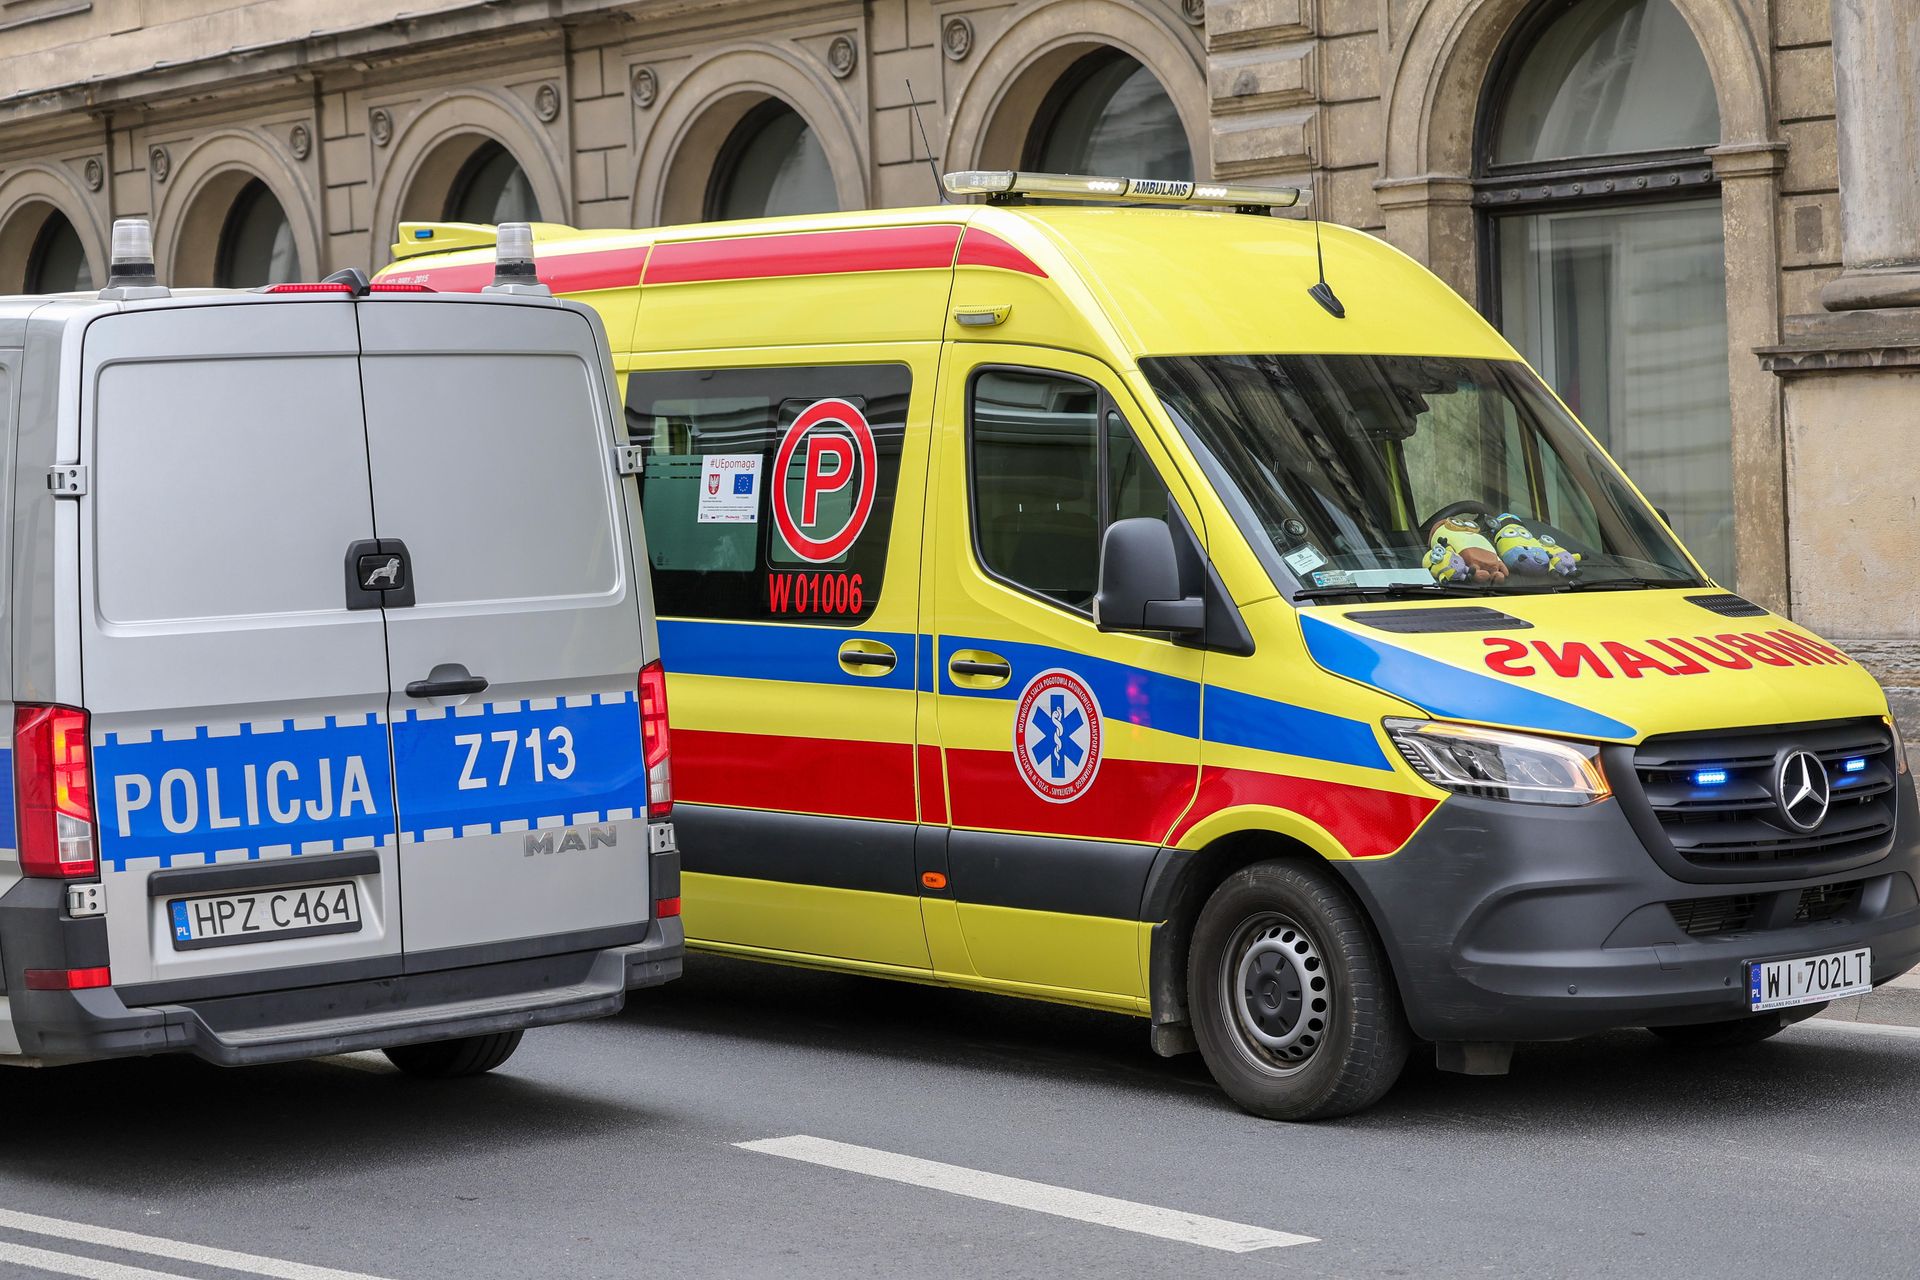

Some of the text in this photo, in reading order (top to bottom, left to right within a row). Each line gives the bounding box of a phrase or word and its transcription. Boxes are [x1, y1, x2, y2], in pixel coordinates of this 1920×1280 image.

[1133, 181, 1188, 196] AMBULANS
[710, 458, 756, 471] #UEpomaga
[800, 434, 855, 528] P
[454, 725, 577, 791] Z713
[113, 755, 378, 838] POLICJA
[523, 826, 618, 857] MAN
[177, 888, 351, 937] PL HPZ C464
[1752, 952, 1866, 999] PL WI 702LT
